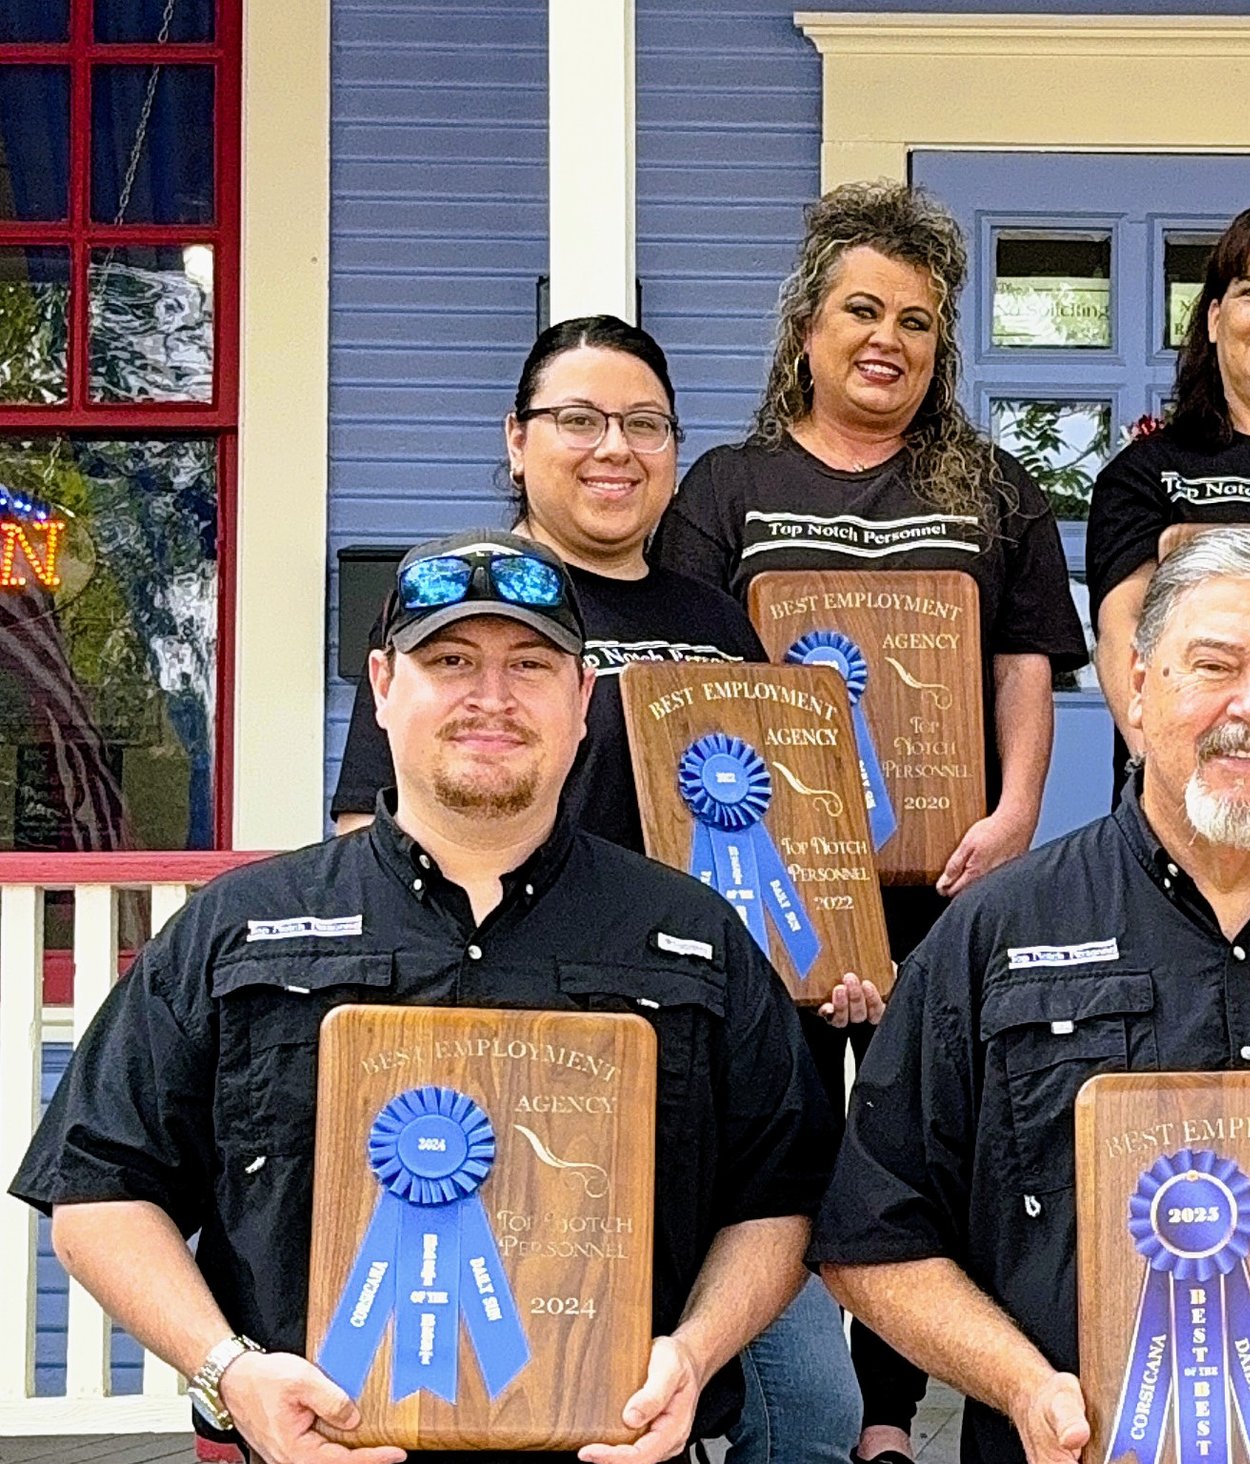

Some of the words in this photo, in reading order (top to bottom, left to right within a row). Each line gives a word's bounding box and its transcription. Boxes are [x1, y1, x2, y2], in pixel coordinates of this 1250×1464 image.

[768, 522, 803, 538] Top
[807, 524, 858, 542] Notch
[863, 523, 947, 544] Personnel
[770, 596, 819, 620] BEST
[824, 592, 963, 622] EMPLOYMENT
[882, 633, 961, 650] AGENCY
[649, 686, 695, 721] BEST
[703, 682, 838, 721] EMPLOYMENT
[765, 728, 838, 747] AGENCY
[904, 797, 950, 810] 2020
[815, 896, 854, 911] 2022
[361, 1046, 424, 1076] BEST
[435, 1038, 622, 1083] EMPLOYMENT
[515, 1095, 617, 1114] AGENCY
[1105, 1123, 1174, 1159] BEST
[1168, 1207, 1220, 1224] 2025
[530, 1297, 597, 1319] 2024
[1189, 1289, 1208, 1363] BEST
[1130, 1334, 1167, 1441] CORSICANA
[1194, 1381, 1212, 1457] BEST
